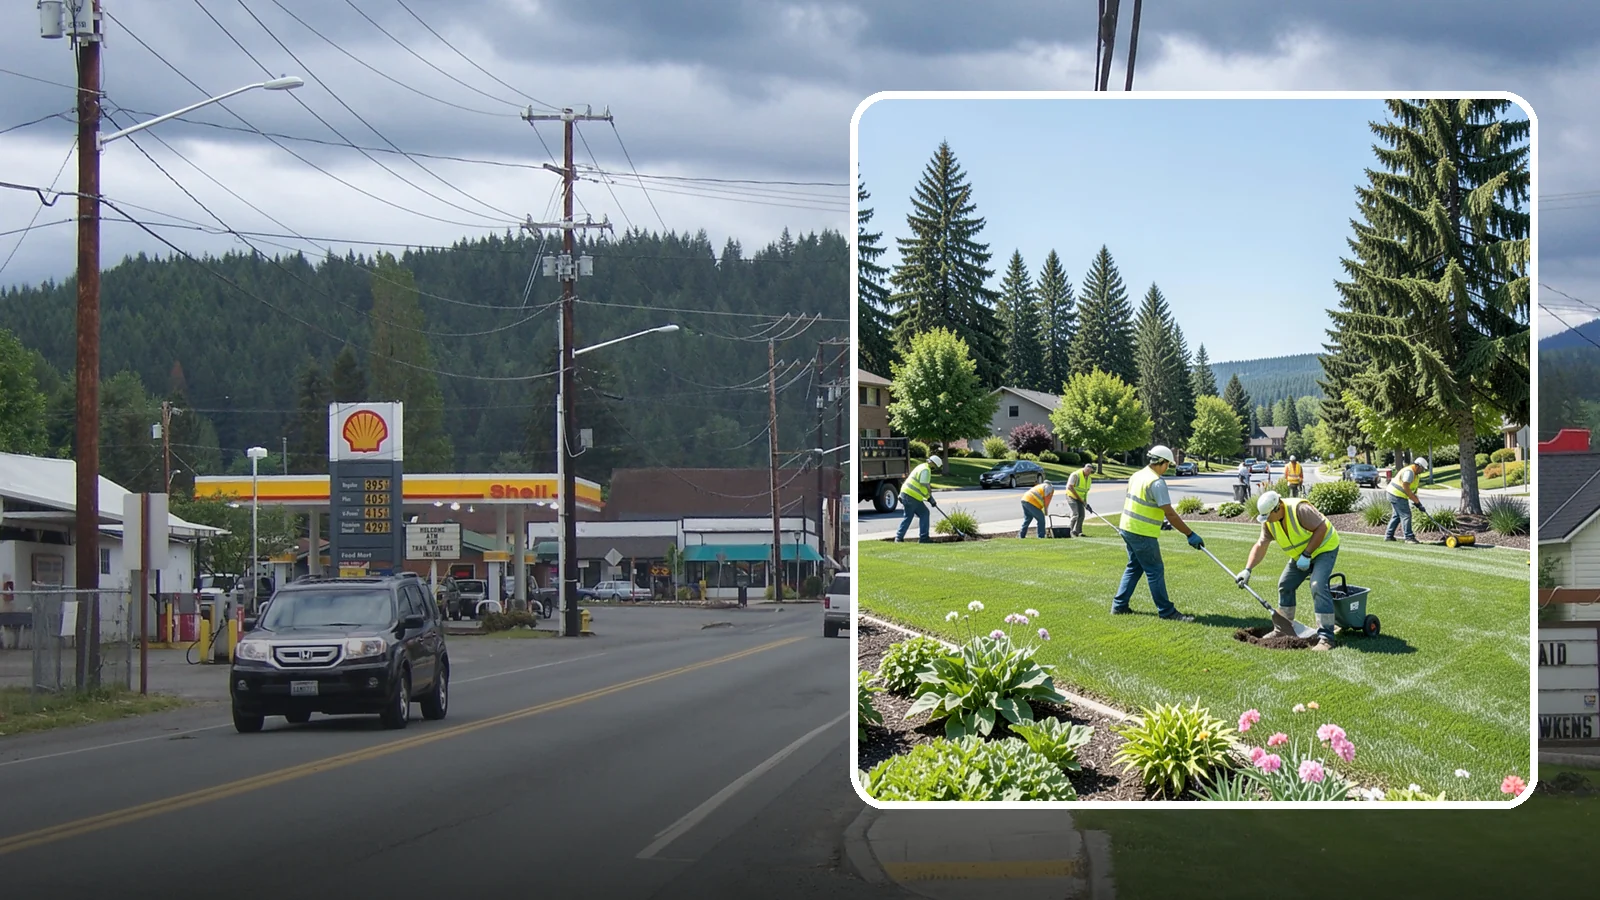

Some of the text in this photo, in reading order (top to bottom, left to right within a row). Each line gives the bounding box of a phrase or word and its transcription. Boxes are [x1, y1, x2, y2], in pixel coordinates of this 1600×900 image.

[365, 480, 384, 490] 395
[490, 484, 547, 499] Shell
[365, 494, 384, 504] 405
[365, 508, 384, 518] 415
[365, 522, 384, 532] 429
[1539, 643, 1566, 665] AID
